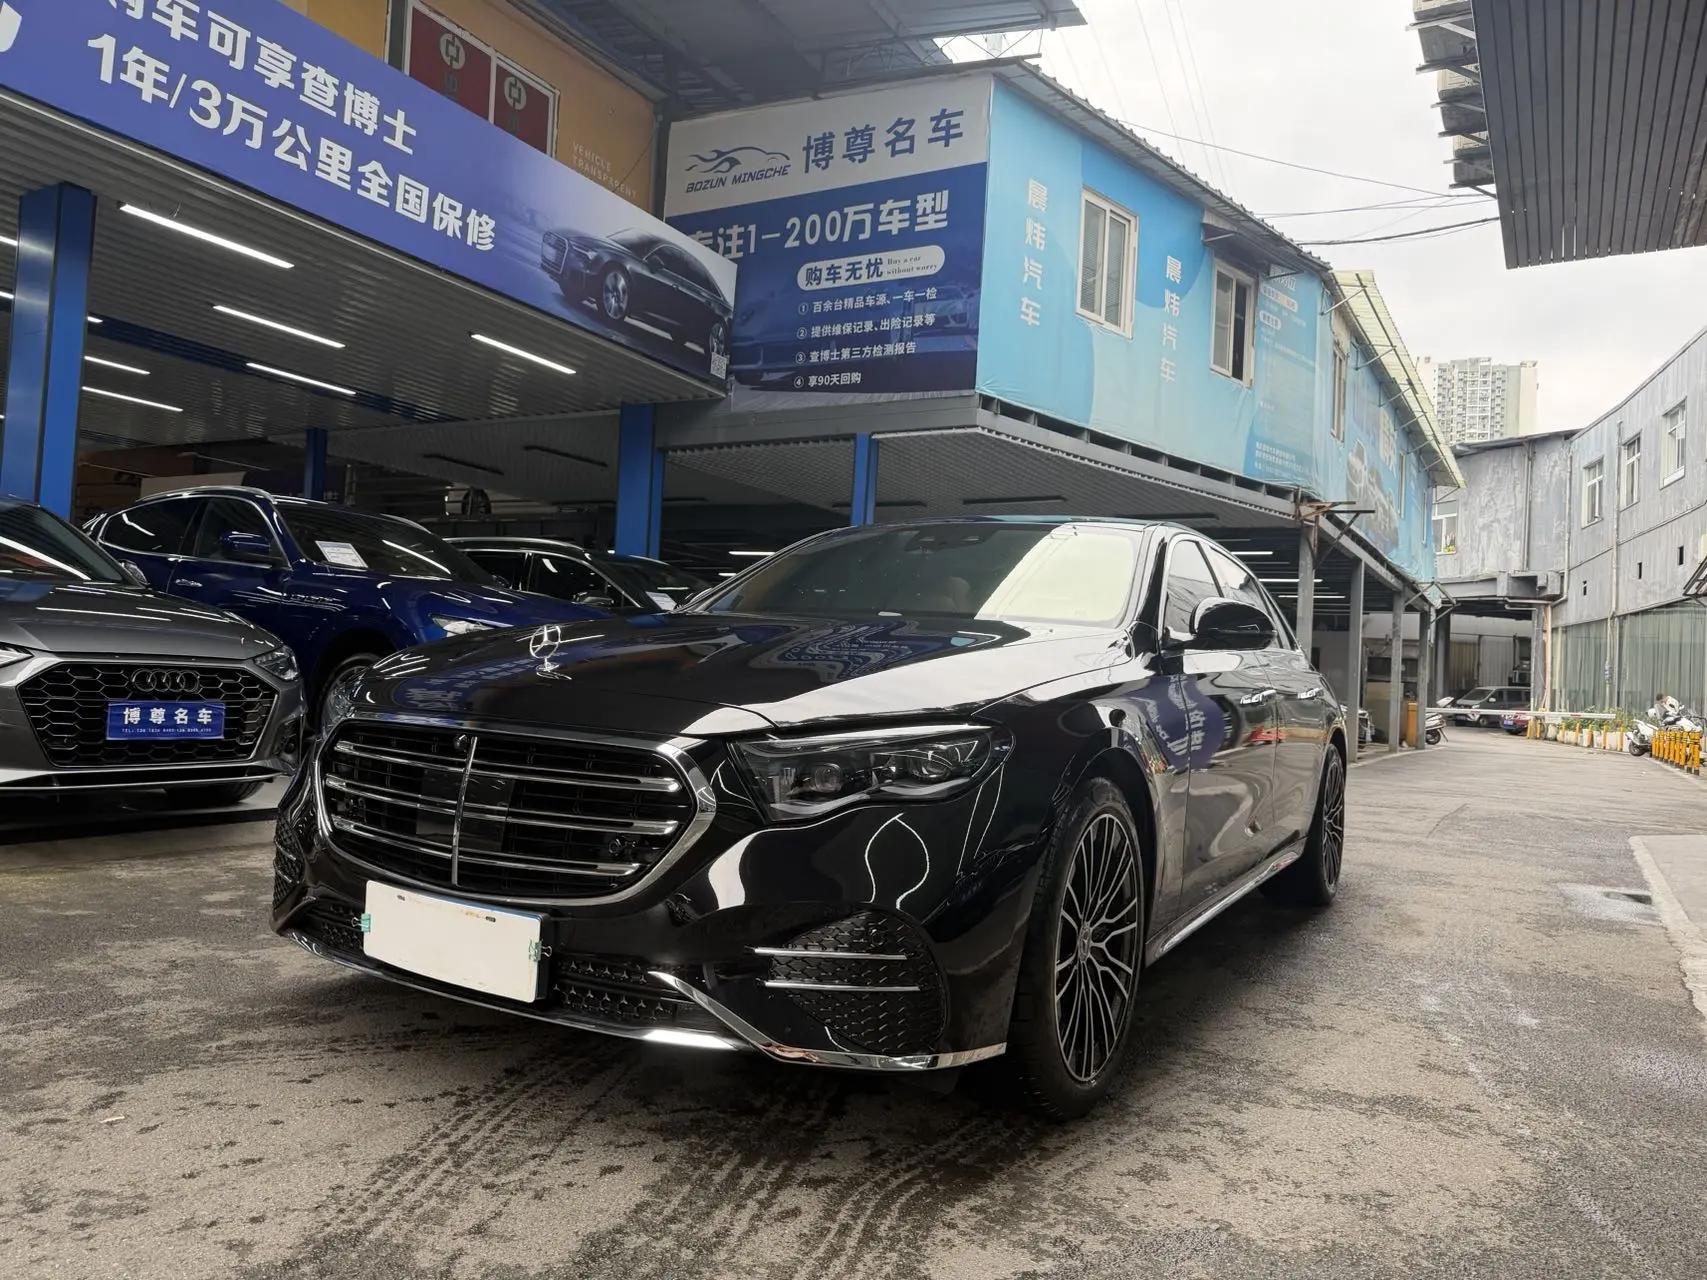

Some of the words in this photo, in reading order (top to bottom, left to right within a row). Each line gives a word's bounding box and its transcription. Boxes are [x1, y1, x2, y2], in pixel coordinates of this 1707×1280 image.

[88, 33, 496, 251] 1年/3万公里全国保修
[572, 141, 611, 172] VEHICLE
[802, 108, 964, 173] 博尊名车
[685, 177, 727, 193] BOZUN
[731, 164, 791, 184] MINGCHE
[805, 258, 883, 286] 购车无忧
[1020, 178, 1048, 326] 晨炜汽车
[1160, 255, 1182, 383] 晨炜汽车
[123, 707, 212, 725] 博尊名车
